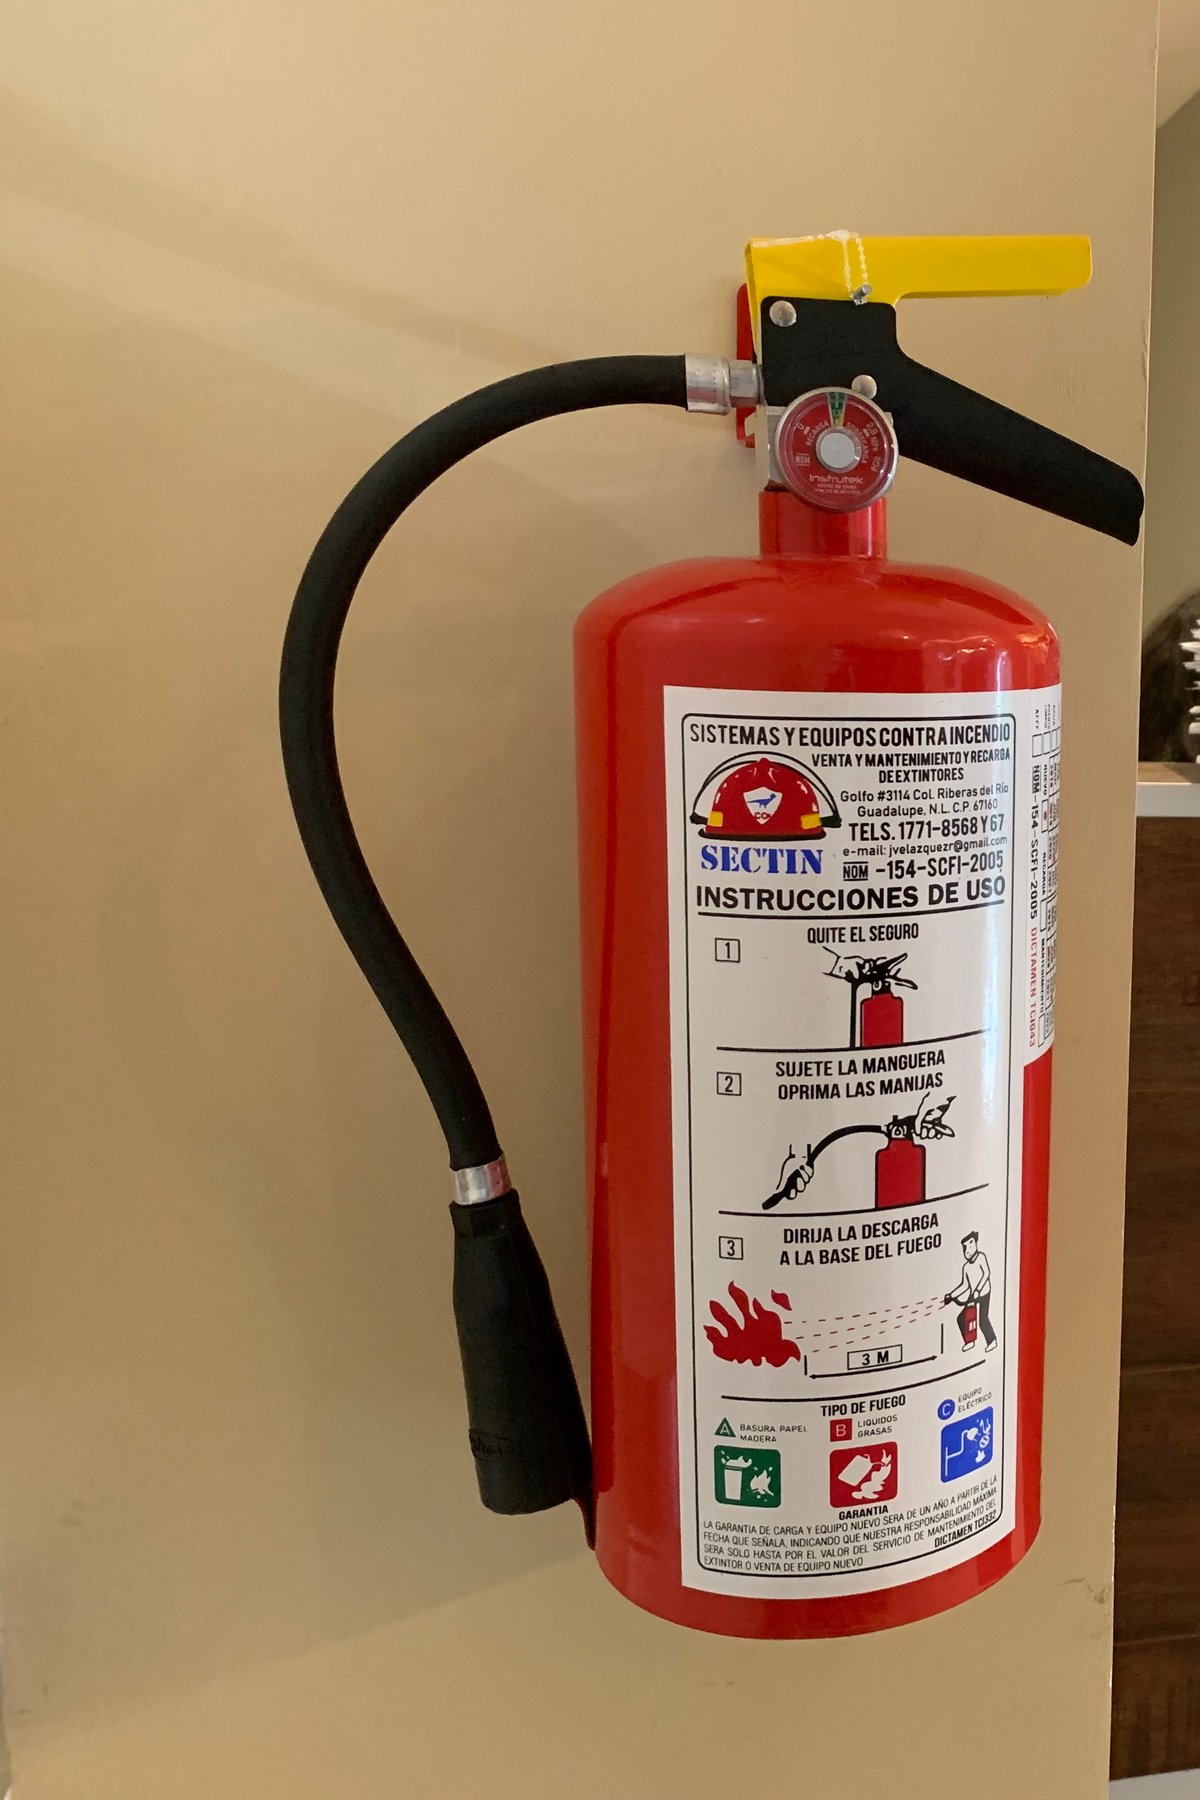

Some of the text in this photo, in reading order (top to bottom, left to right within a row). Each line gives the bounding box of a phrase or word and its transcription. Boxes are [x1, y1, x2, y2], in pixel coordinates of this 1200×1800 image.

[795, 456, 811, 464] NOM
[690, 722, 1010, 747] SISTEMAS Y EQUIPOS CONTRA INCENDIO
[811, 747, 1010, 767] VENTA Y MANTENIMIENTO Y RECARGA
[878, 767, 964, 784] DE EXTINTORES
[840, 781, 1009, 802] Golfo #3114 Col. Riberas del Río
[857, 798, 998, 818] Guadalupe, N.L. C.P. 67160
[848, 813, 1005, 842] TELS. 1771-8568 Y 67
[842, 835, 1008, 858] e-mail: jvelazquezr@gmail.com
[701, 845, 823, 875] SECTIN
[842, 849, 1004, 880] NOM -154-SCFI-2005
[696, 875, 1006, 911] INSTRUCCIONES DE USO
[807, 922, 919, 945] QUITE EL SEGURO
[724, 942, 731, 959] 1
[775, 1049, 946, 1077] SUJETE LA MANGUERA
[724, 1075, 734, 1093] 2
[778, 1072, 944, 1100] OPRIMA LAS MANIJAS
[783, 1213, 939, 1244] DIRIJA LA DESCARGA
[726, 1240, 736, 1256] 3
[779, 1232, 942, 1266] A LA BASE DEL FUEGO
[861, 1350, 889, 1366] 3 M
[957, 1387, 983, 1403] EQUIPO
[820, 1394, 906, 1418] TIPO DE FUEGO
[942, 1403, 951, 1416] C
[719, 1423, 731, 1436] A
[739, 1423, 808, 1433] BASURA PAPEL
[835, 1423, 847, 1437] B
[857, 1414, 898, 1428] LIQUIDOS
[739, 1433, 777, 1443] MADERA
[857, 1425, 893, 1438] GRASAS
[703, 1475, 998, 1535] LA GARANTIA DE CARGA Y EQUIPO NUEVO SERA DE UN AÑO A PARTIR DE LA
[838, 1505, 889, 1520] GARANTIA
[703, 1532, 730, 1544] FECHA
[732, 1536, 749, 1547] QUE
[751, 1535, 788, 1549] SEÑALA,
[790, 1535, 841, 1548] INDICANDO
[843, 1531, 861, 1544] QUE
[863, 1525, 903, 1541] NUESTRA
[903, 1500, 972, 1532] RESPONSABILIDAD
[703, 1499, 996, 1560] SERA SOLO HASTA POR EL VALOR DEL SERVICIO DE MANTENIMIENTO DEL
[934, 1508, 997, 1548] DICTAMEN TCI332
[703, 1556, 863, 1572] EXTINTOR O VENTA DE EQUIPO NUEVO
